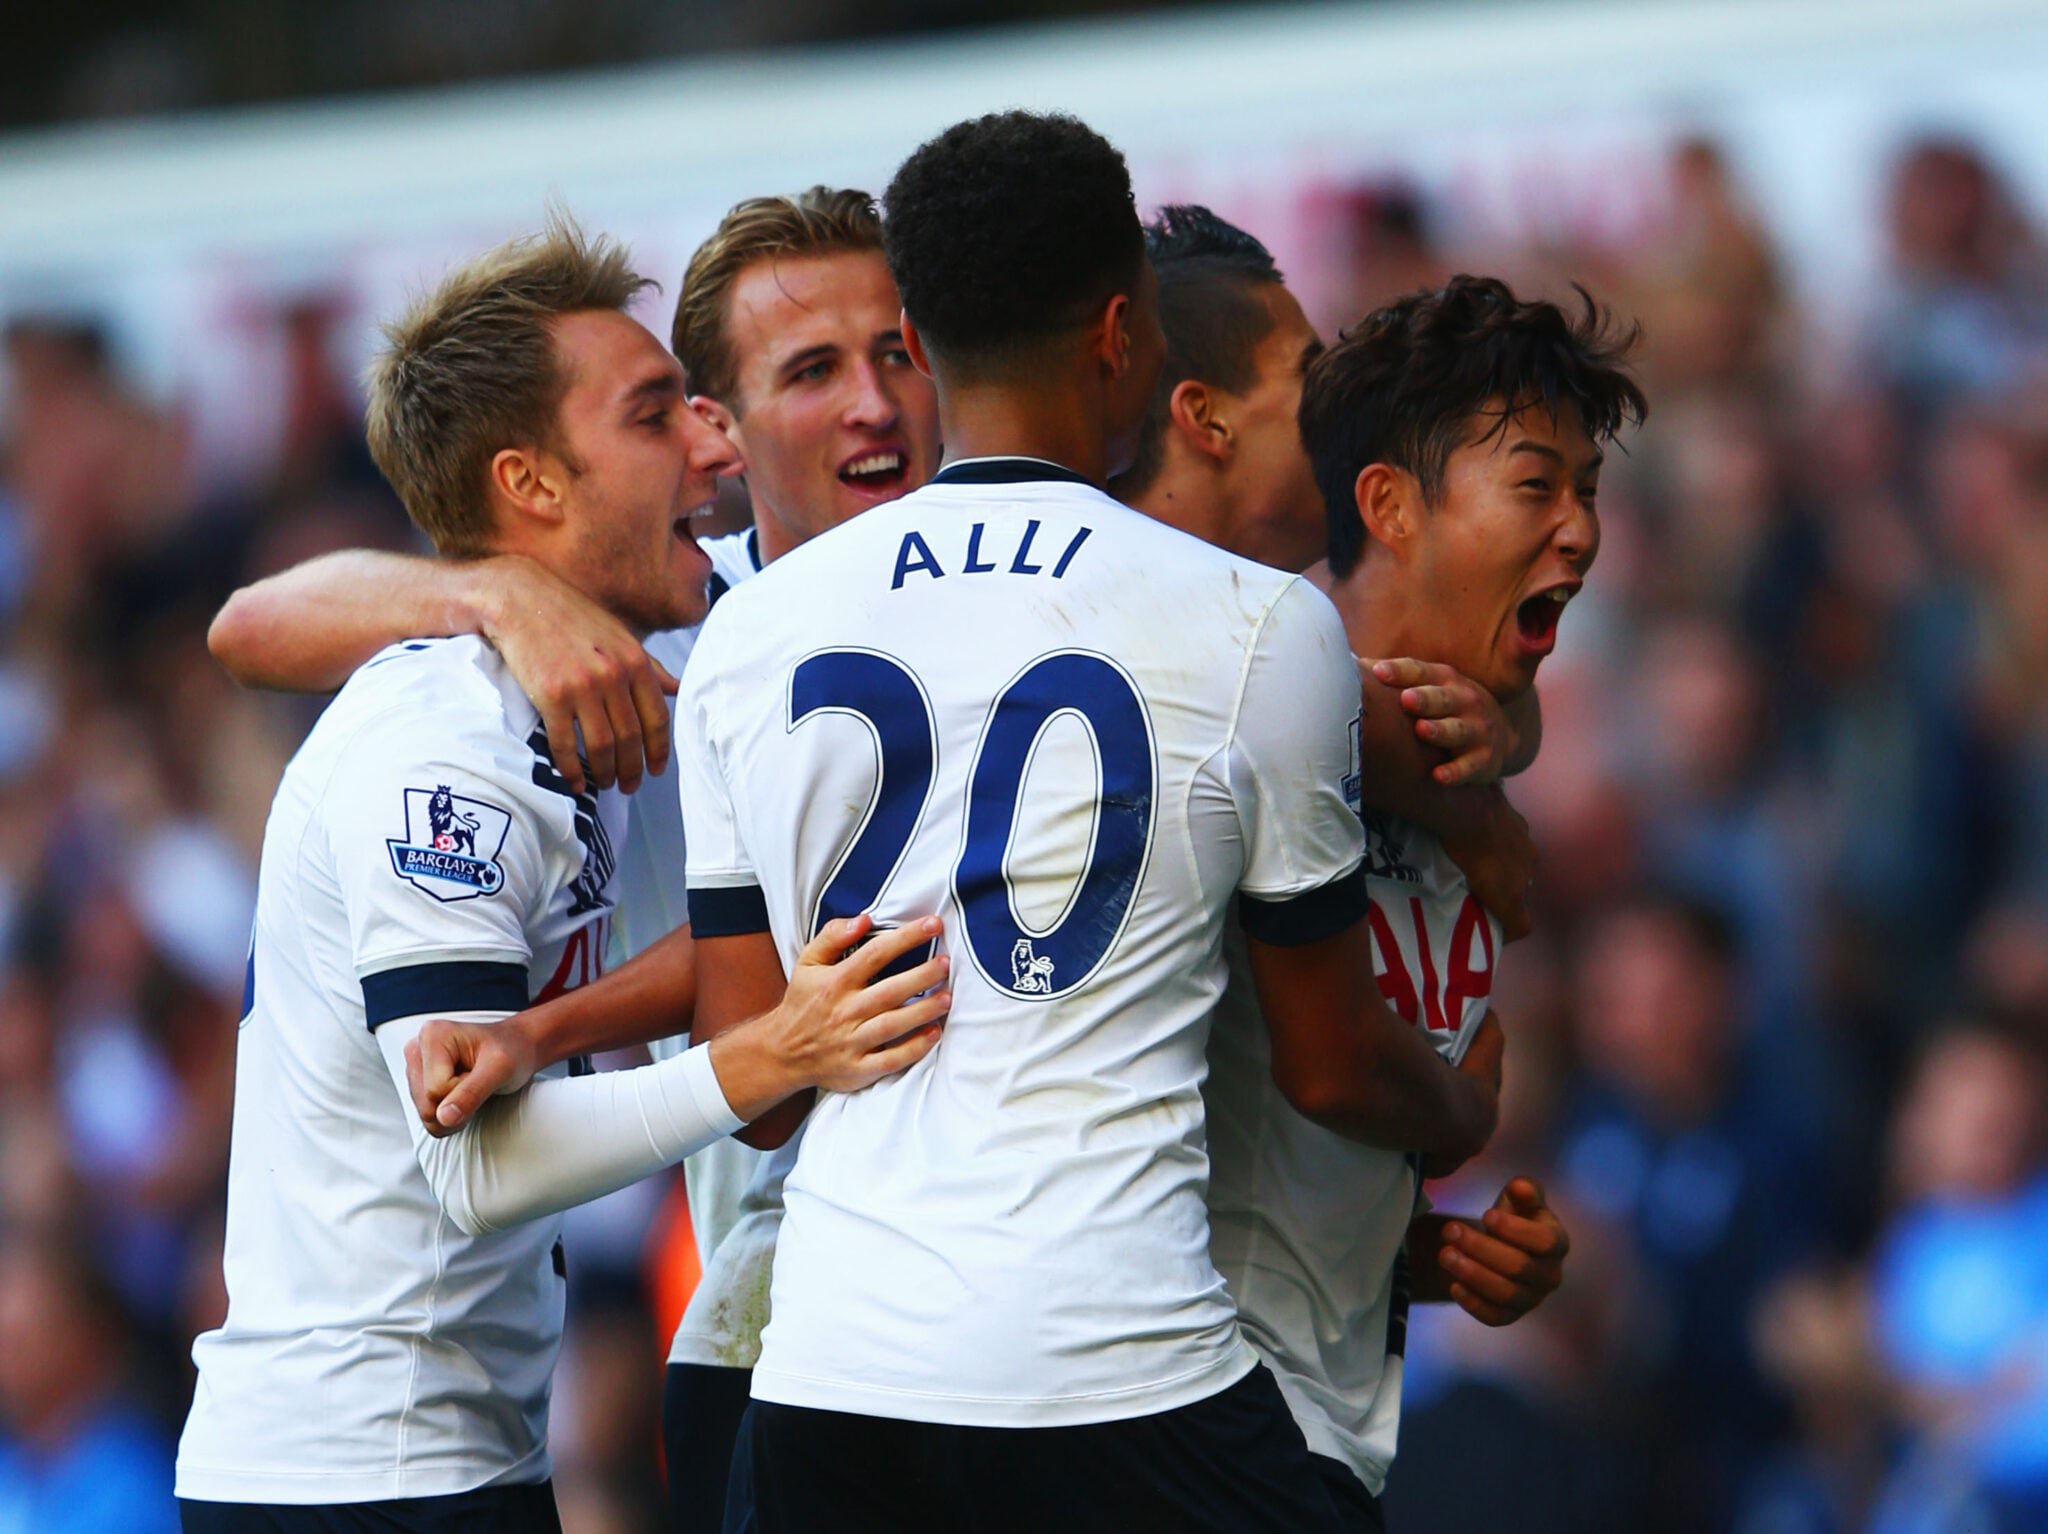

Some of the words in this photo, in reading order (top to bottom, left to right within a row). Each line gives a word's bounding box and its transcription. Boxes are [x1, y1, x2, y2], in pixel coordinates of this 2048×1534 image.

[890, 519, 1093, 591] ALLI
[786, 645, 1160, 1002] 20
[404, 862, 441, 876] PREMIER
[442, 869, 474, 882] LEAGUE
[406, 850, 477, 875] BARCLAYS
